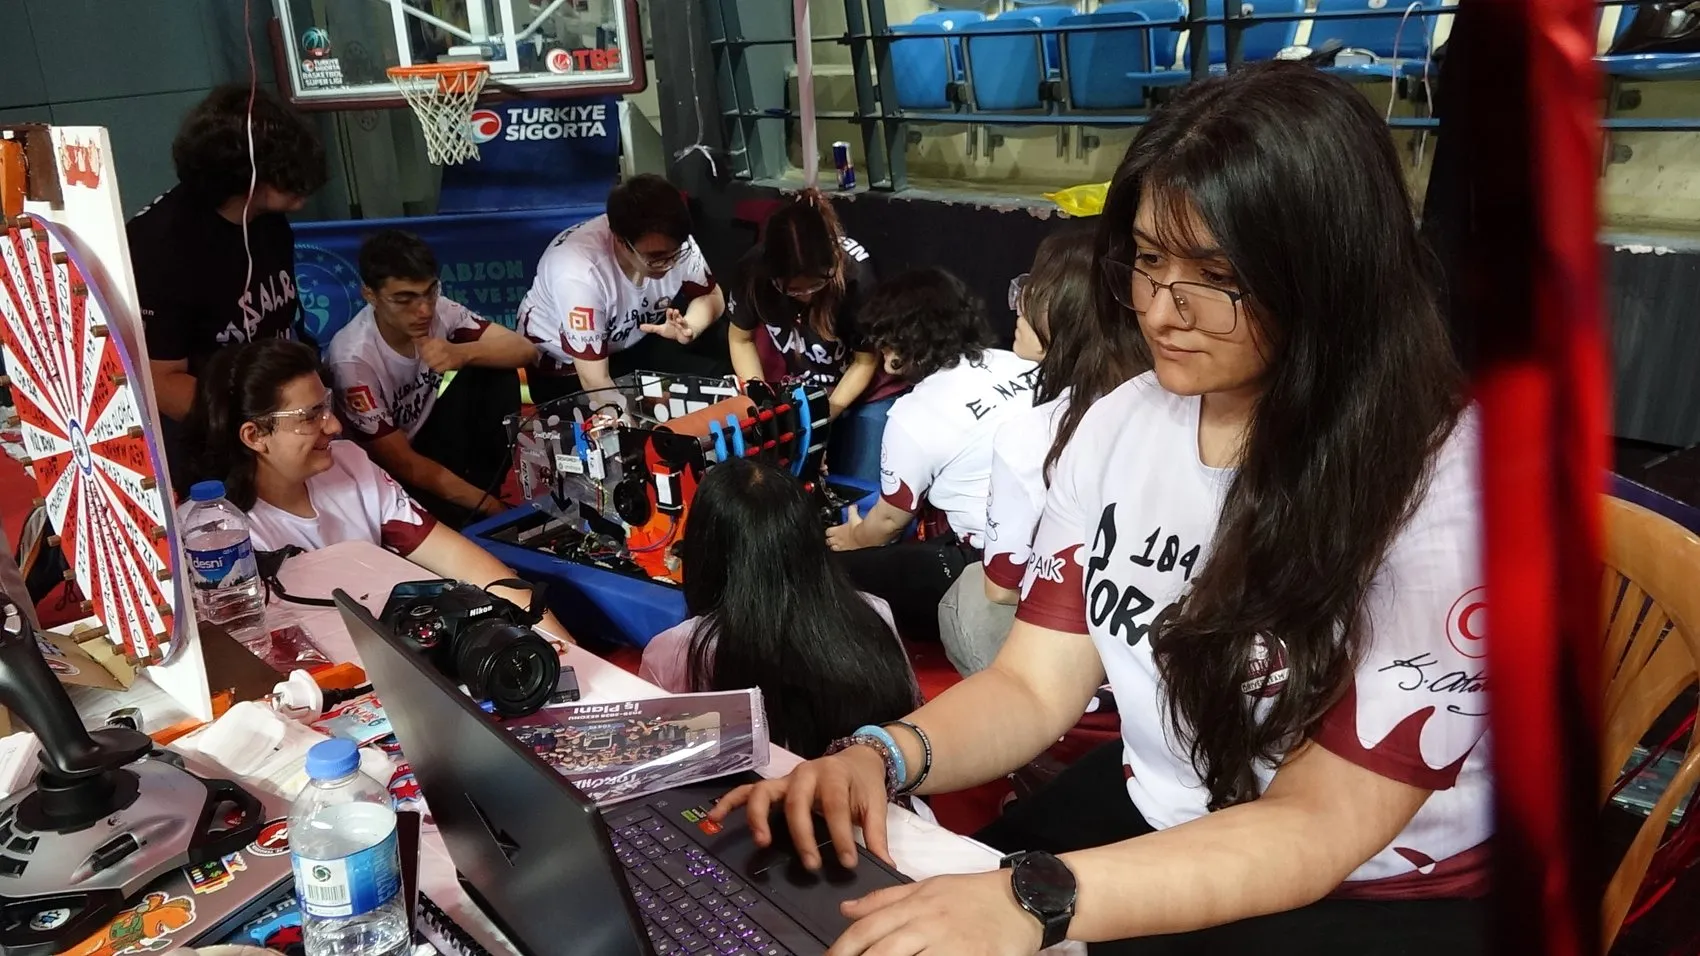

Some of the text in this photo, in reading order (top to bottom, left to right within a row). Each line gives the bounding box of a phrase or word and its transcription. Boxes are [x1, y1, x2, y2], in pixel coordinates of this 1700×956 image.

[505, 121, 606, 141] SIGORTA
[441, 261, 523, 281] ABZON
[474, 288, 501, 303] VE
[469, 605, 493, 617] Nikon
